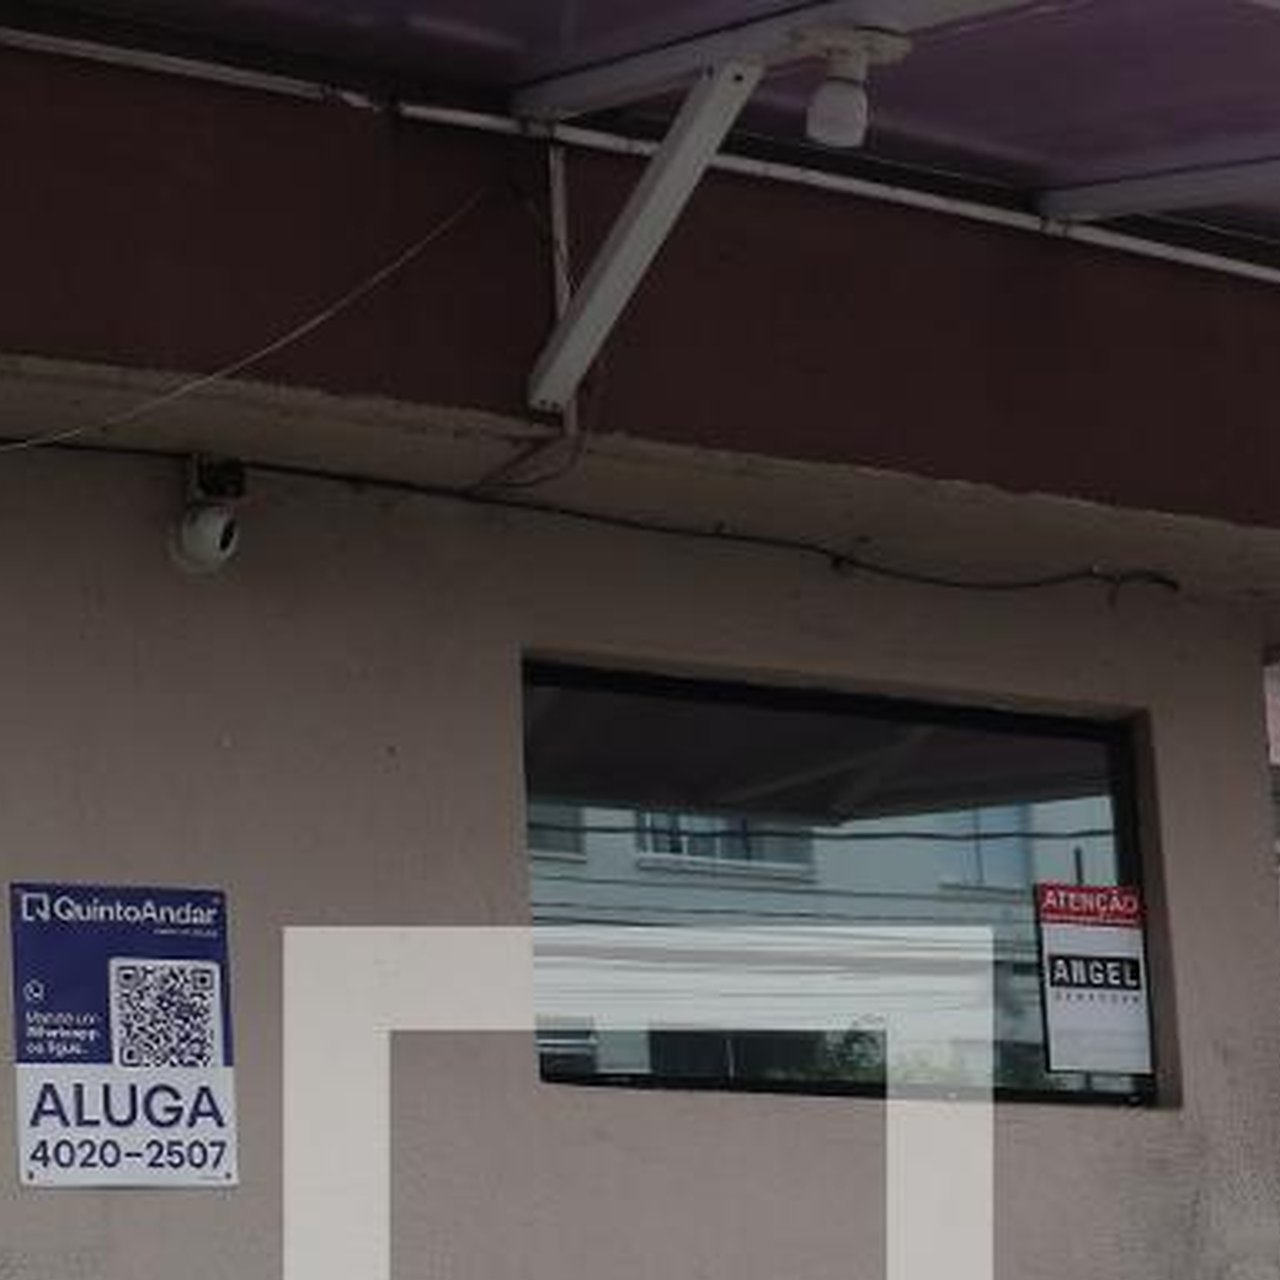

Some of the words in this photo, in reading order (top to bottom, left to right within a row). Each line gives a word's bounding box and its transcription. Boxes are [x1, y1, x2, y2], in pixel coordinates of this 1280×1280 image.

[53, 895, 217, 924] QuintoAndar
[1042, 889, 1139, 917] ATENÇÃO
[1053, 959, 1138, 987] ANGEL
[29, 1083, 225, 1128] ALUGA
[29, 1139, 227, 1169] 4020-2507
